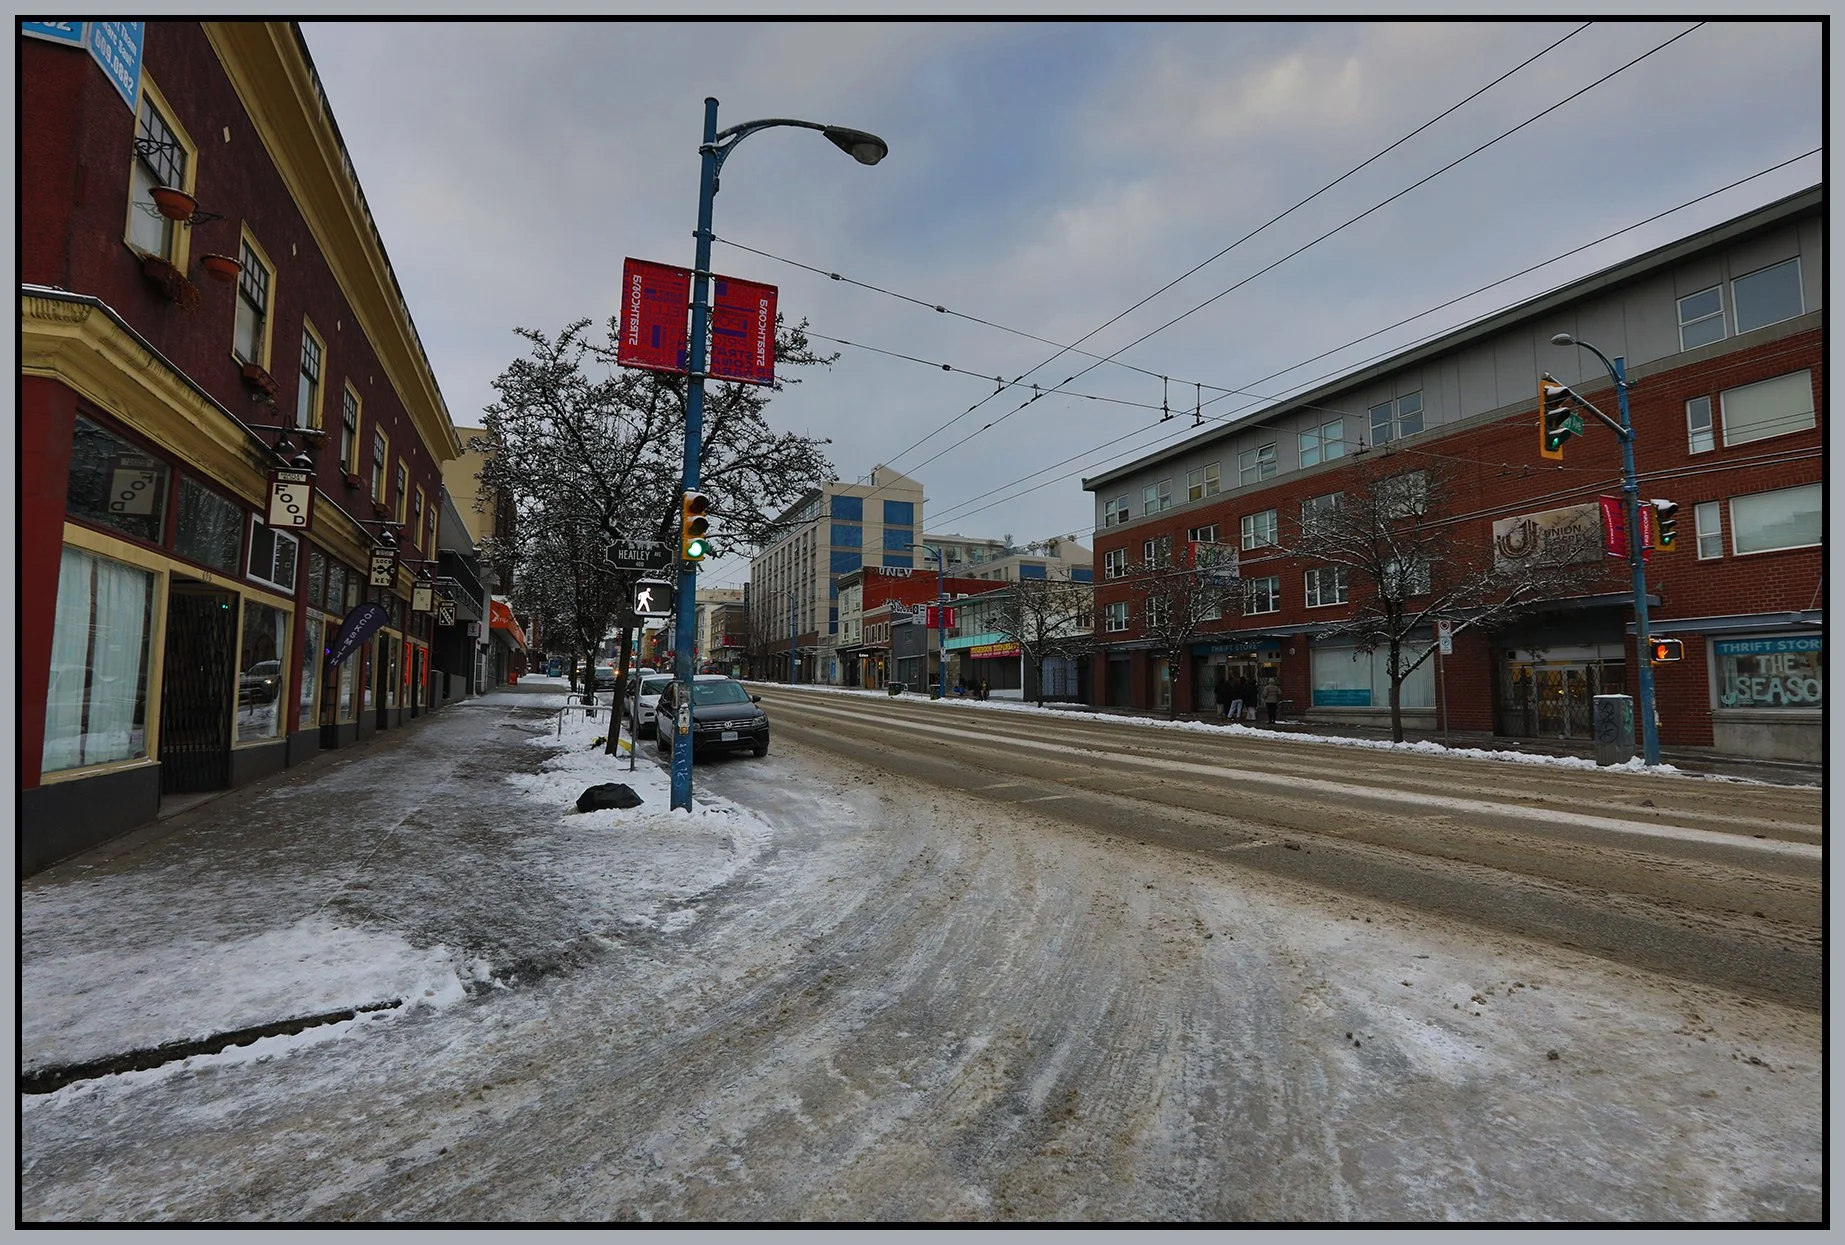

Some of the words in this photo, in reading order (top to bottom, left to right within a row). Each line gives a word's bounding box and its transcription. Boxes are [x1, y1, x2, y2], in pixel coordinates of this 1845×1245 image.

[274, 484, 306, 525] FOOD
[1543, 525, 1581, 537] UNION
[618, 549, 651, 561] HEATLEY
[330, 607, 376, 666] LOCKSMITH
[1719, 641, 1773, 653] THRIFT
[1776, 639, 1822, 651] STOR
[1756, 654, 1796, 675] THE
